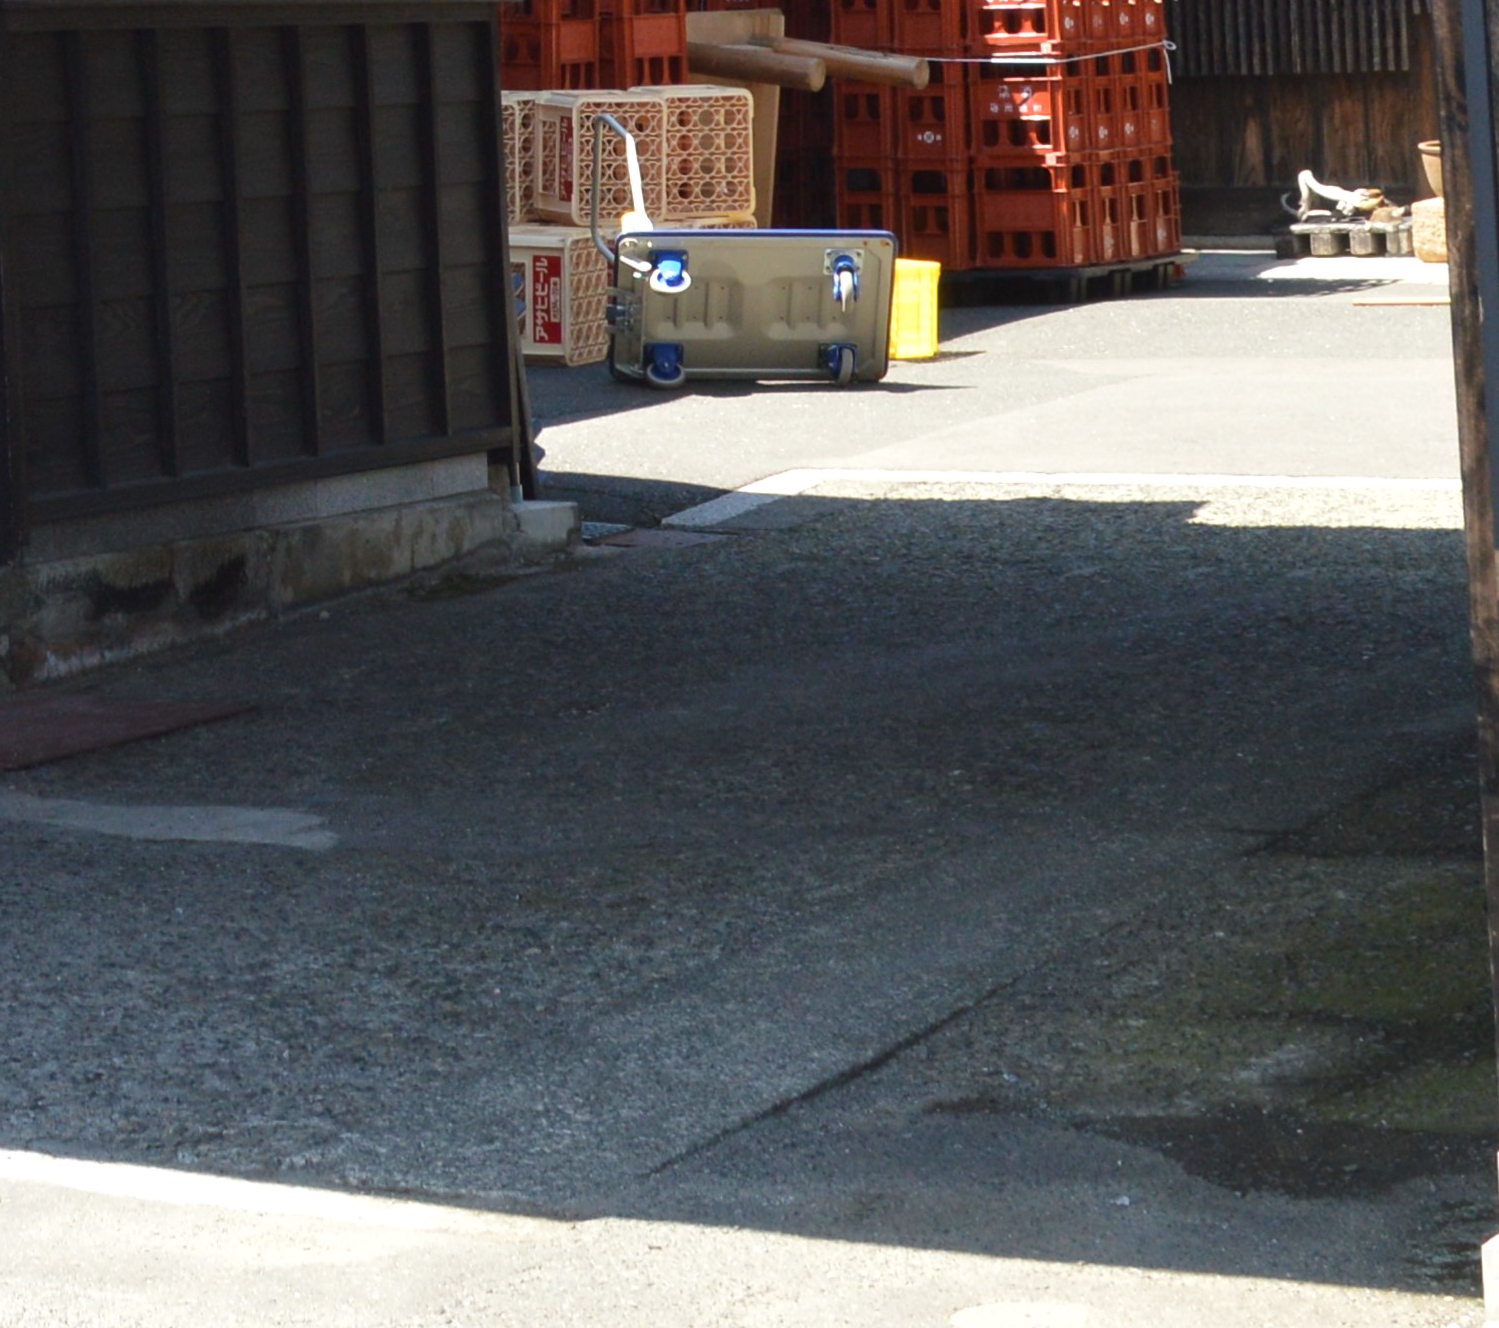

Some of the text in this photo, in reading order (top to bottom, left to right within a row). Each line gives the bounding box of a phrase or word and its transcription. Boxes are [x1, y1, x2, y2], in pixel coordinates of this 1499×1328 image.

[535, 257, 549, 341] アサヒビール
